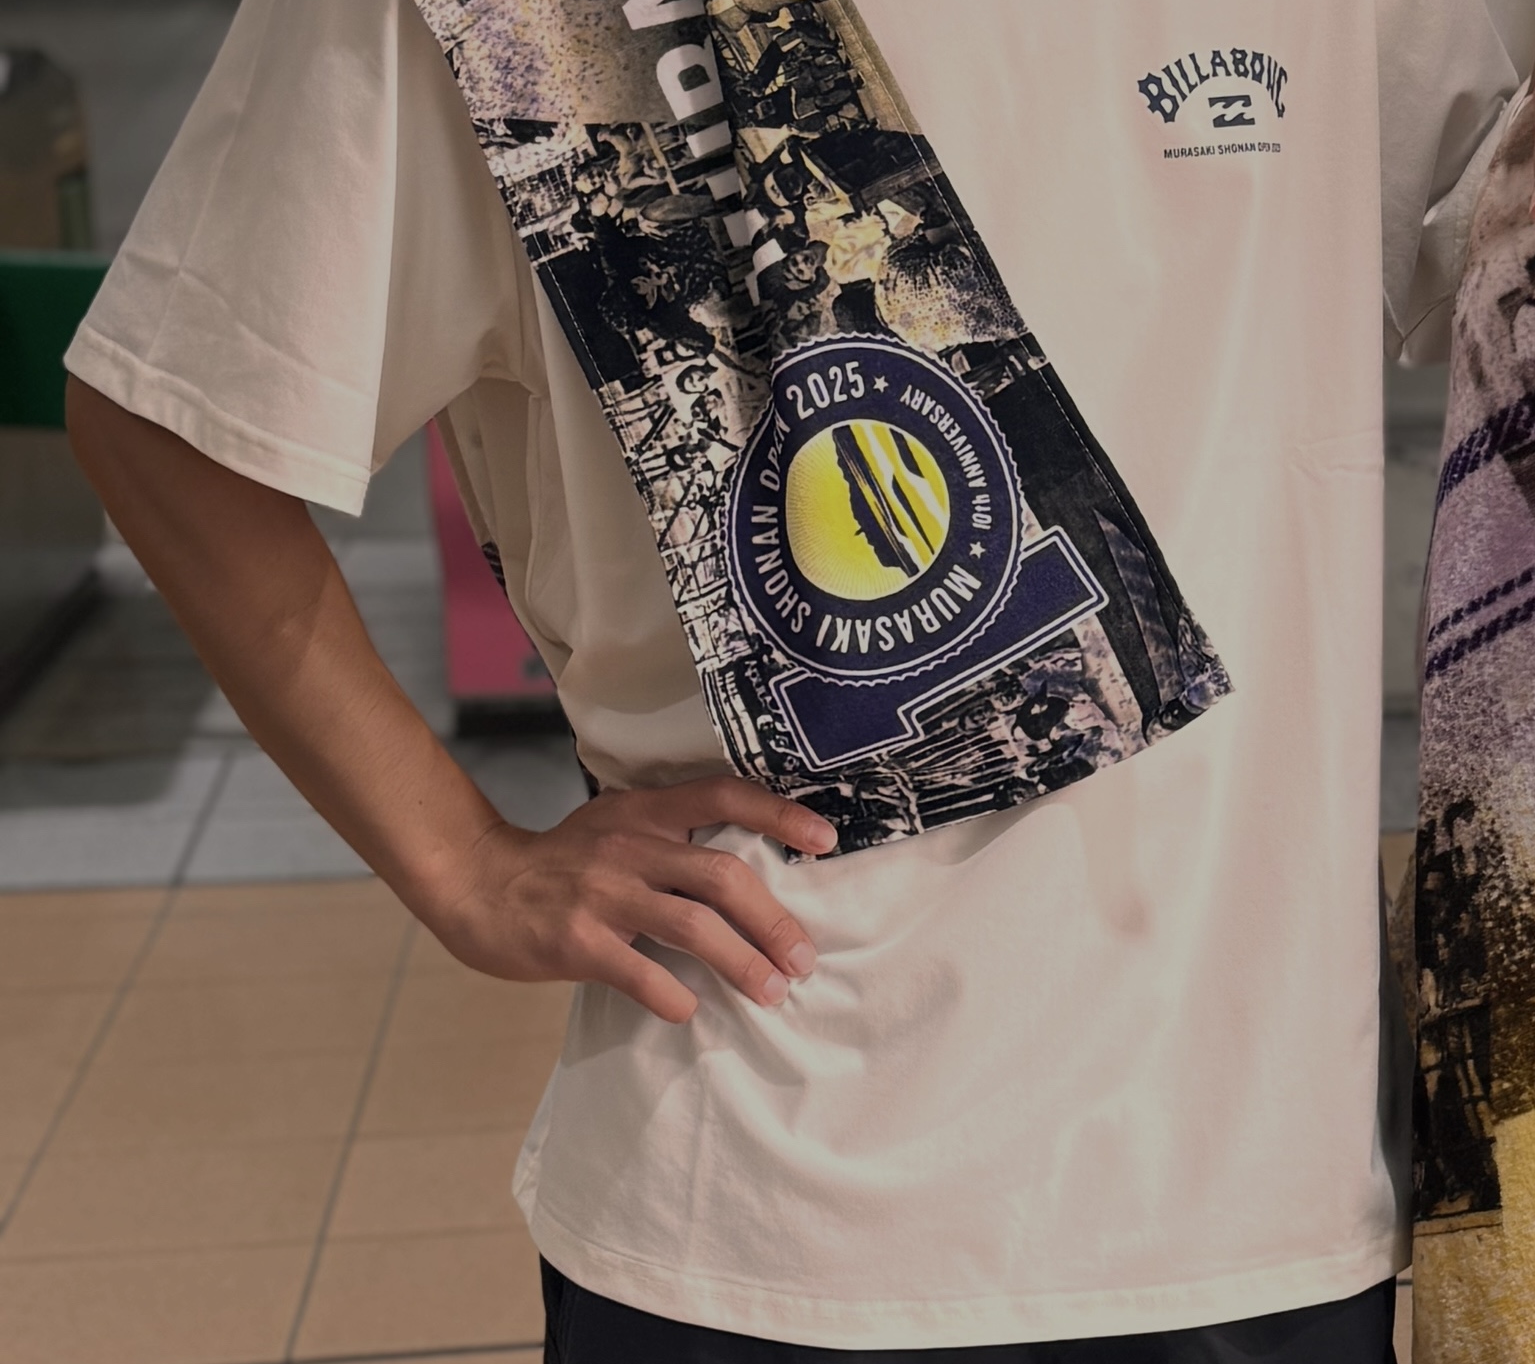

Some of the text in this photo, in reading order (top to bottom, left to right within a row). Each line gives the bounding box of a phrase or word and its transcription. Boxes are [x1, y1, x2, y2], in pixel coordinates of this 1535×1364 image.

[1163, 145, 1215, 159] MURASAKI
[1218, 142, 1256, 155] SHONAN
[785, 361, 866, 421] 2025
[899, 384, 993, 531] 10th ANNIVERSARY
[751, 504, 812, 634] SHONAN
[815, 564, 982, 655] MURASAKI
